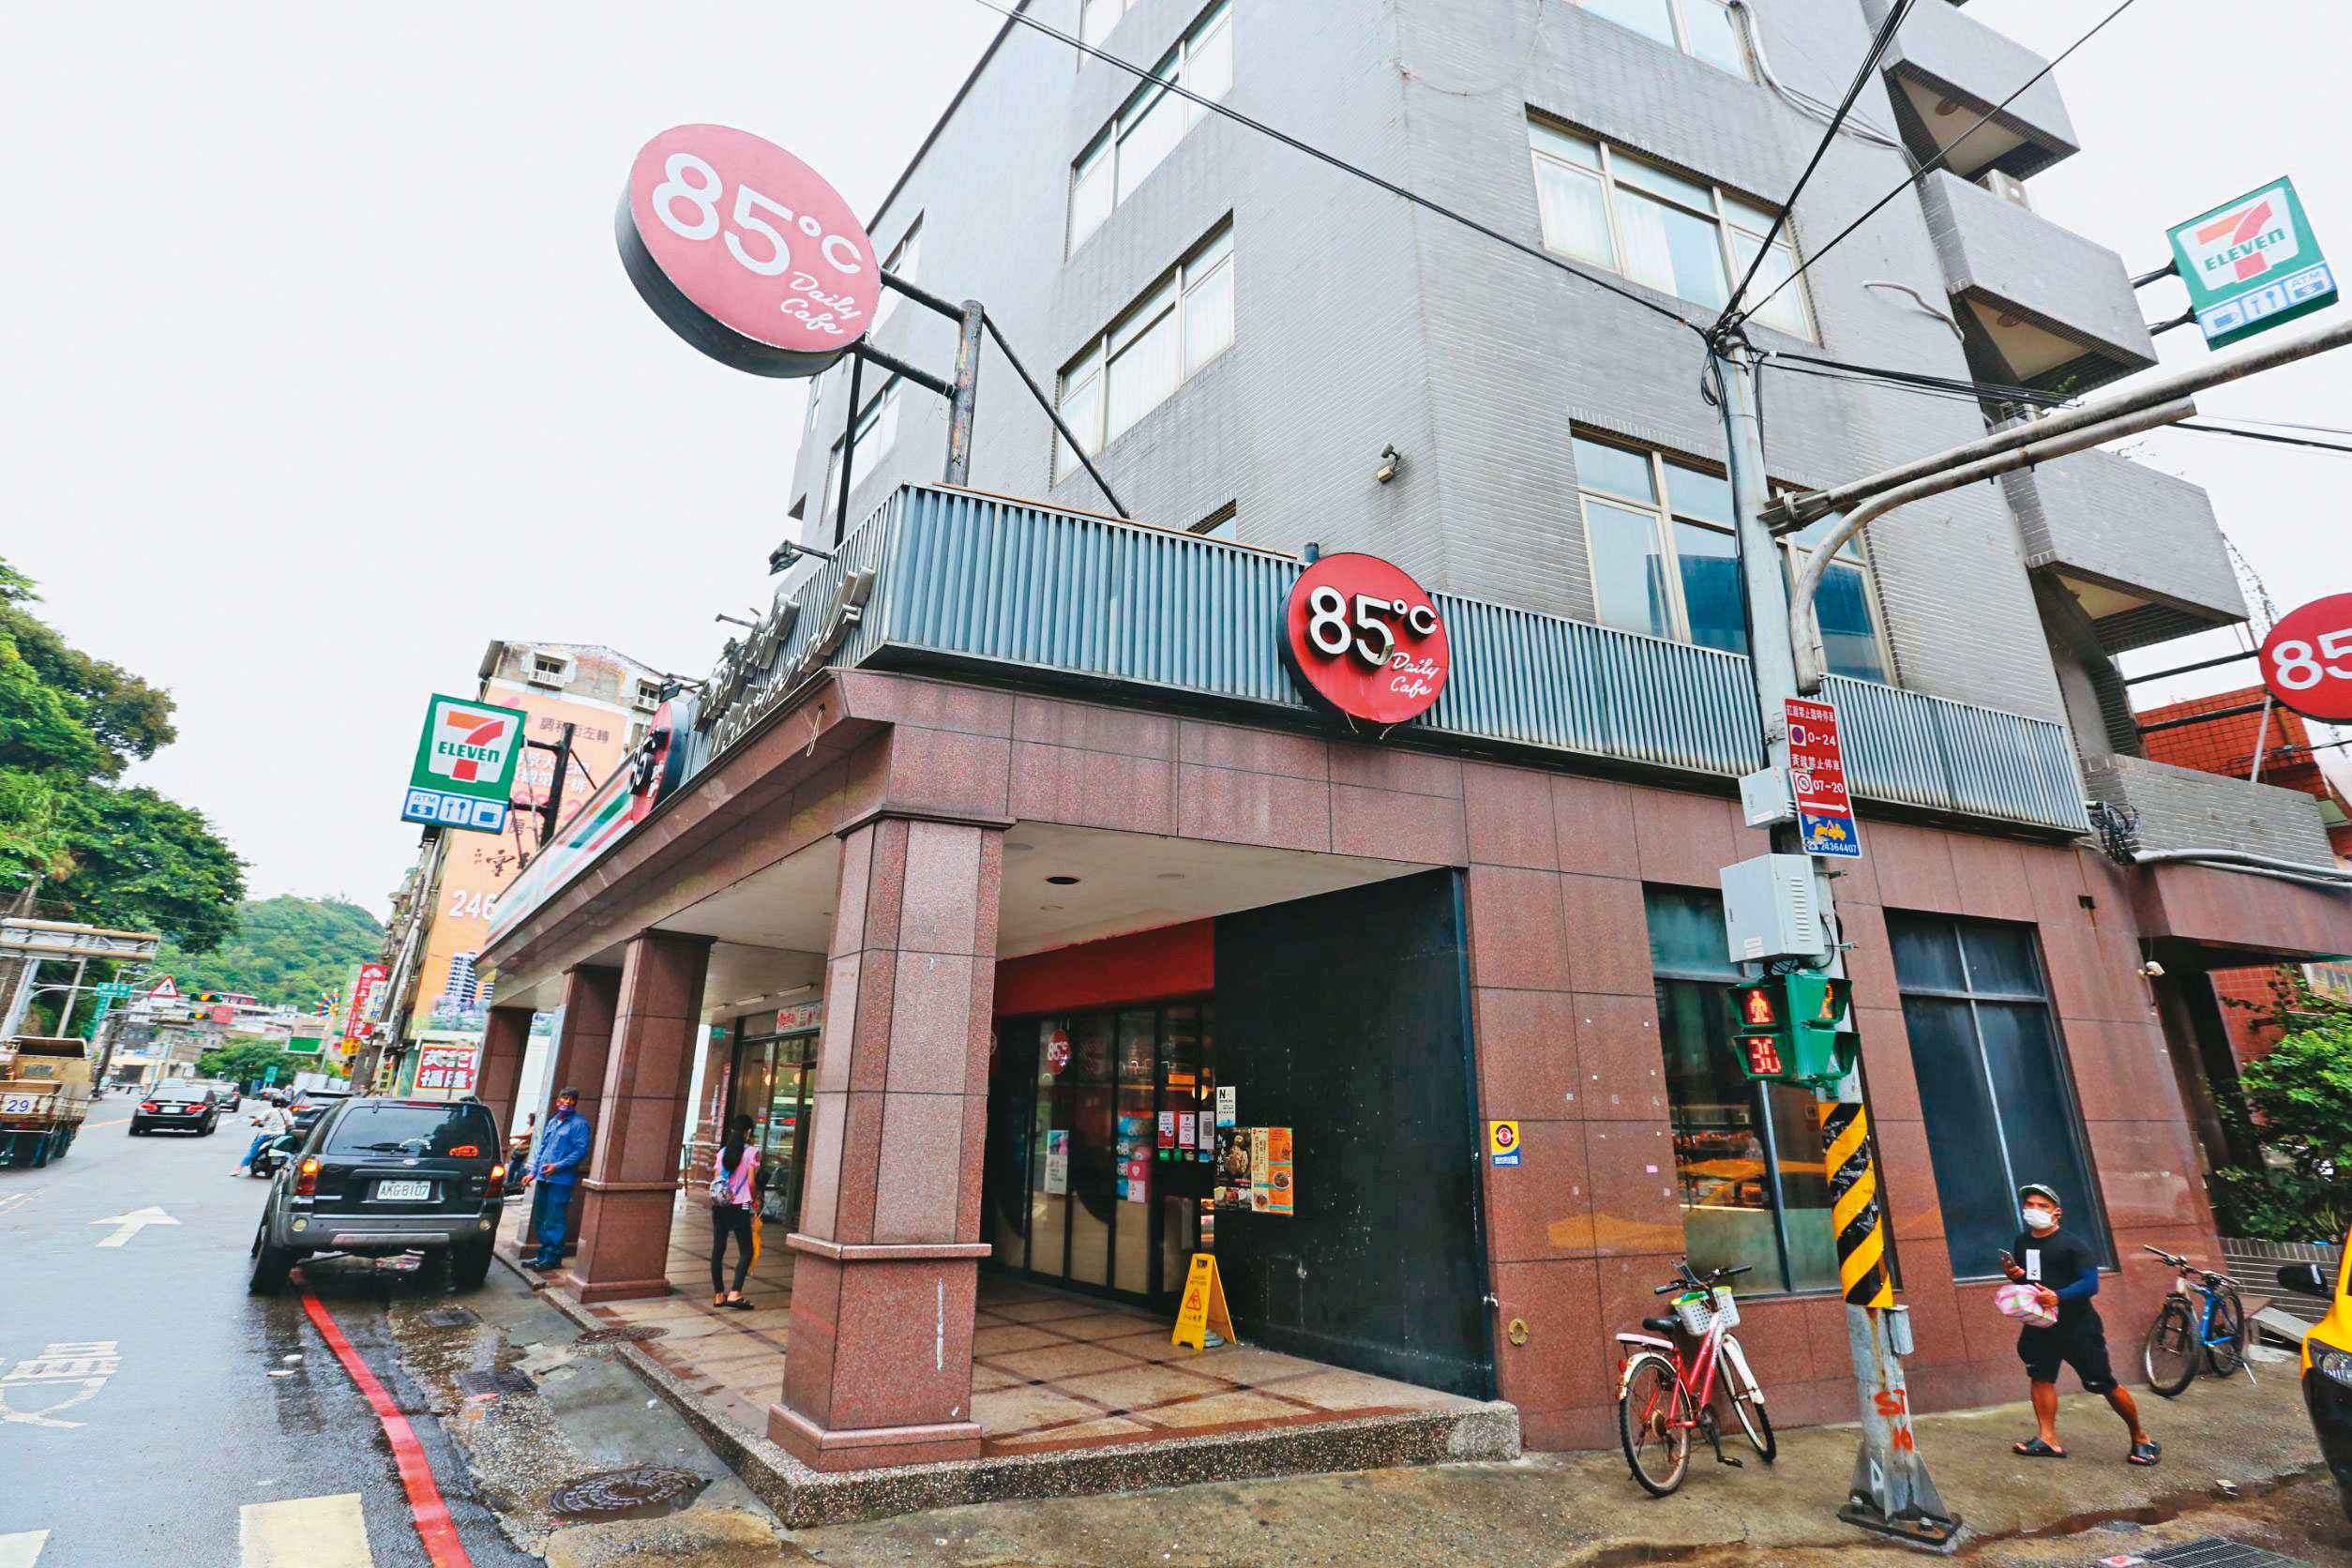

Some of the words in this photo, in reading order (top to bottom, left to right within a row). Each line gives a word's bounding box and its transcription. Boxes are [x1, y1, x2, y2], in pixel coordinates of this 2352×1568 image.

[790, 270, 862, 321] Daily
[779, 297, 845, 335] Cafe
[1392, 652, 1440, 679] Daily
[1390, 676, 1432, 699] Cafe
[1808, 731, 1837, 746] 0-24
[1813, 778, 1845, 794] 07-20
[413, 794, 436, 805] ATM
[6, 1100, 29, 1113] 29
